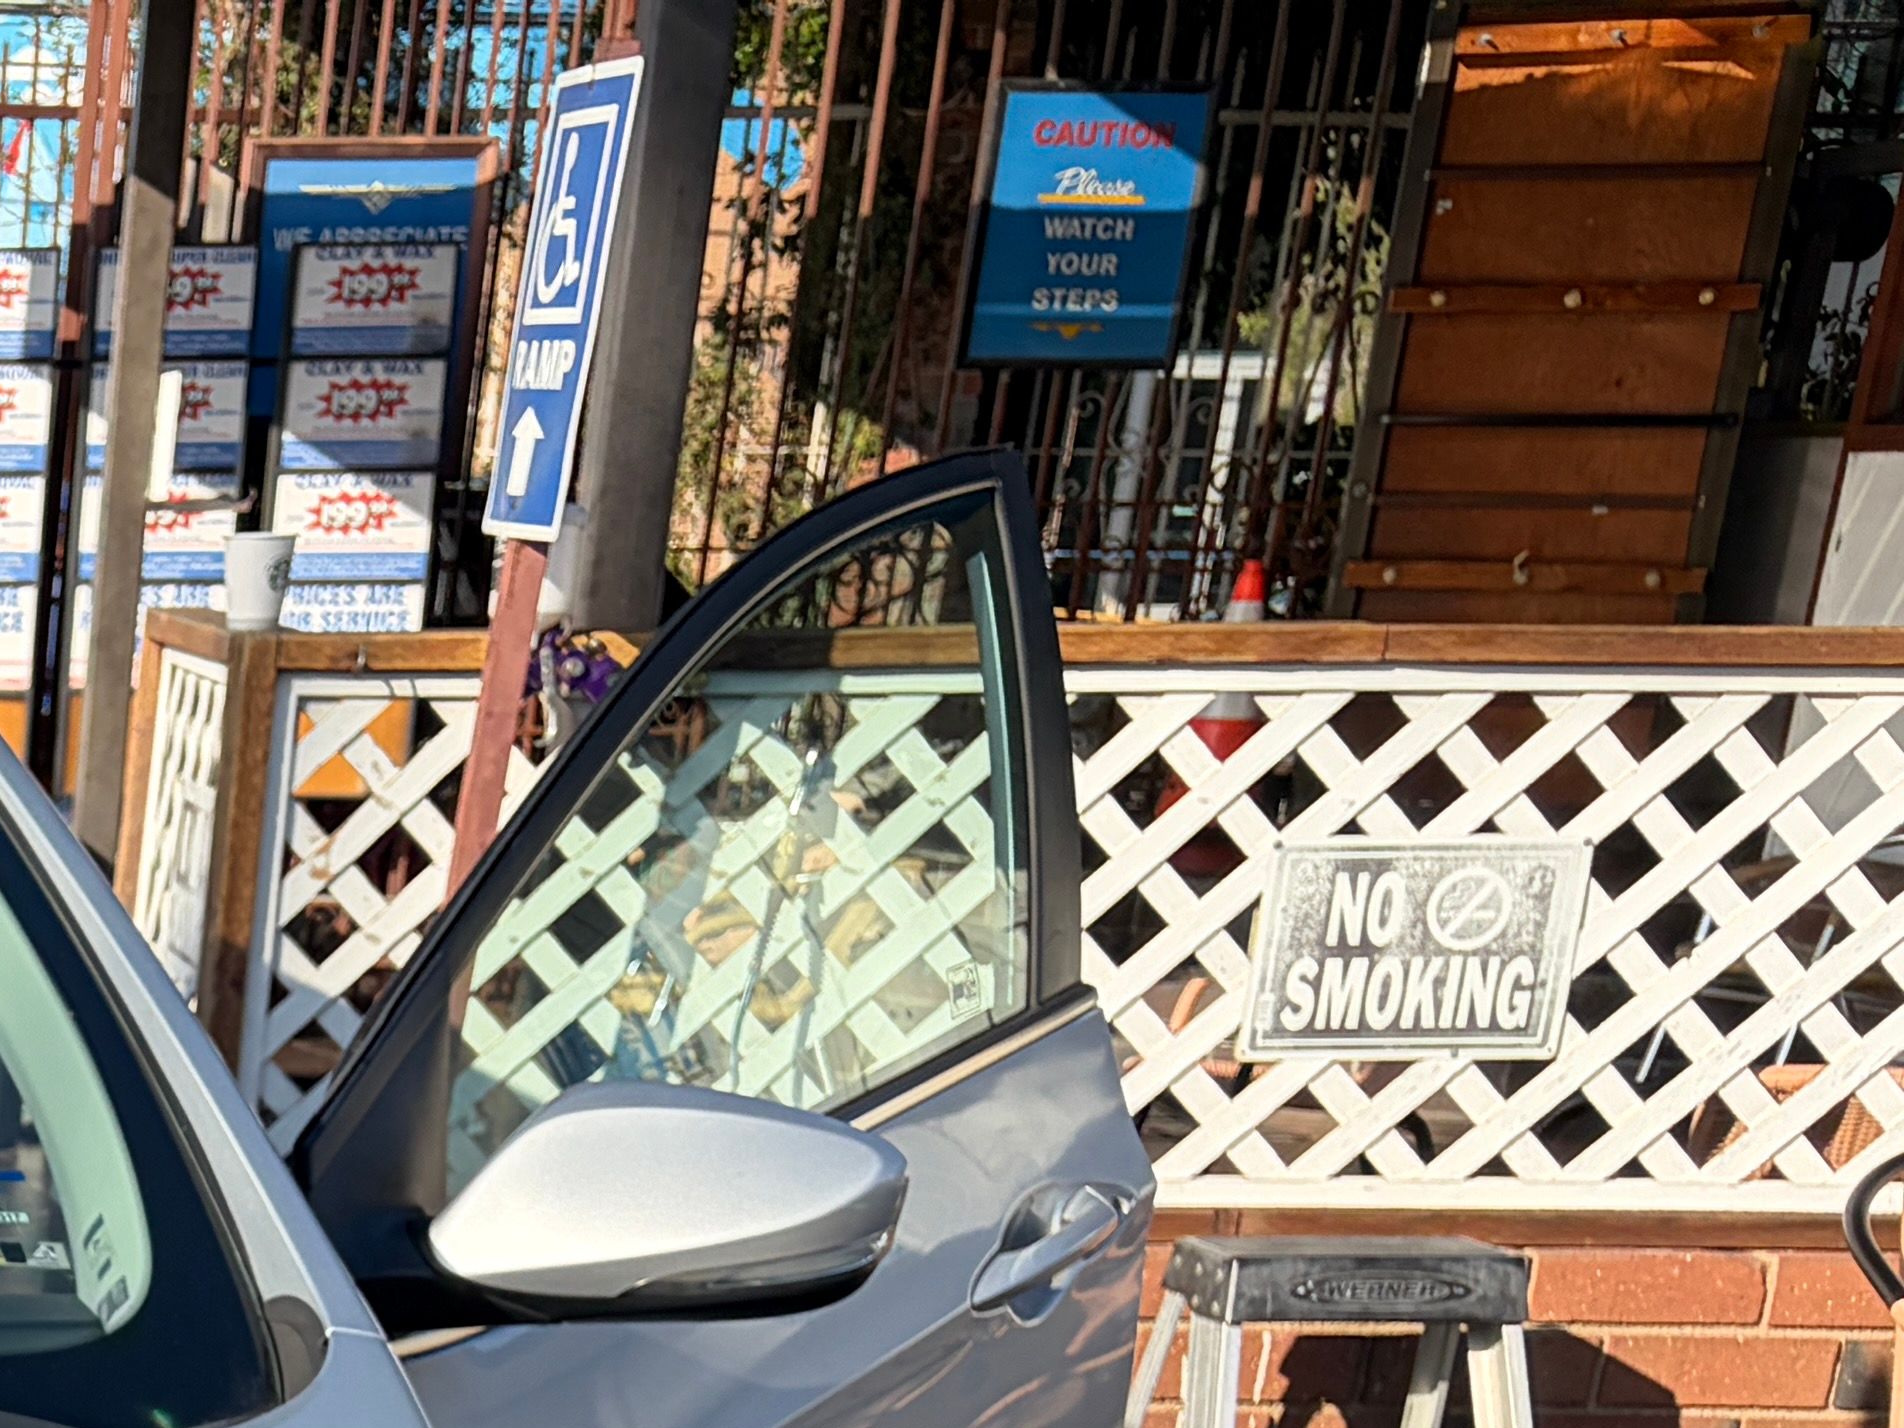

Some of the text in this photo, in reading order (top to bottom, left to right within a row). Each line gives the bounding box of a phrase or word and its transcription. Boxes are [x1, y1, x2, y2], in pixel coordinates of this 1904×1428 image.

[1033, 119, 1176, 149] CAUTION
[1054, 166, 1136, 196] Please
[1044, 216, 1135, 241] WATCH
[1046, 252, 1118, 276] YOUR
[1031, 287, 1121, 313] STEPS
[512, 339, 576, 391] RAMP
[1325, 871, 1406, 947] NO
[1280, 955, 1535, 1031] SMOKING
[1323, 1278, 1451, 1301] WERNER
